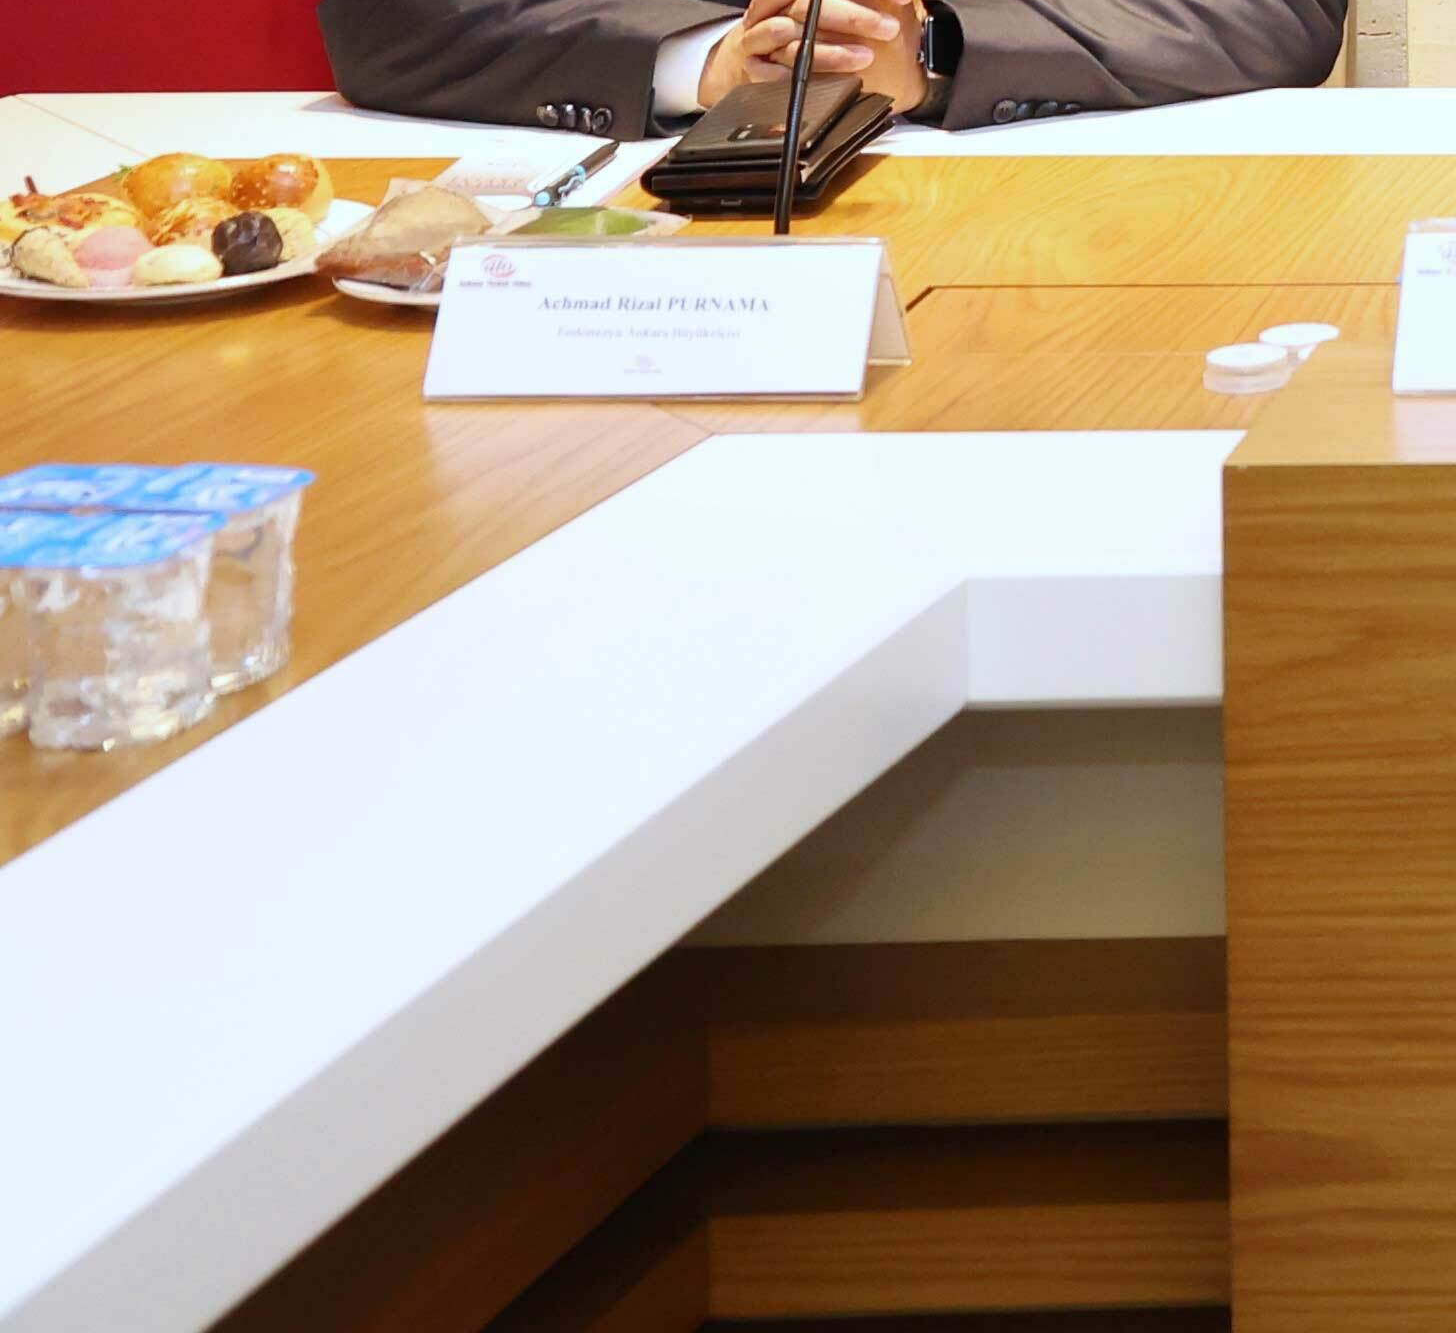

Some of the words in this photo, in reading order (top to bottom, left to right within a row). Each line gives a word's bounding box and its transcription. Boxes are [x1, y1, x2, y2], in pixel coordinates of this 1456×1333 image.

[538, 296, 612, 311] Achmad
[617, 296, 662, 311] Rizal
[666, 296, 770, 312] PURNAMA
